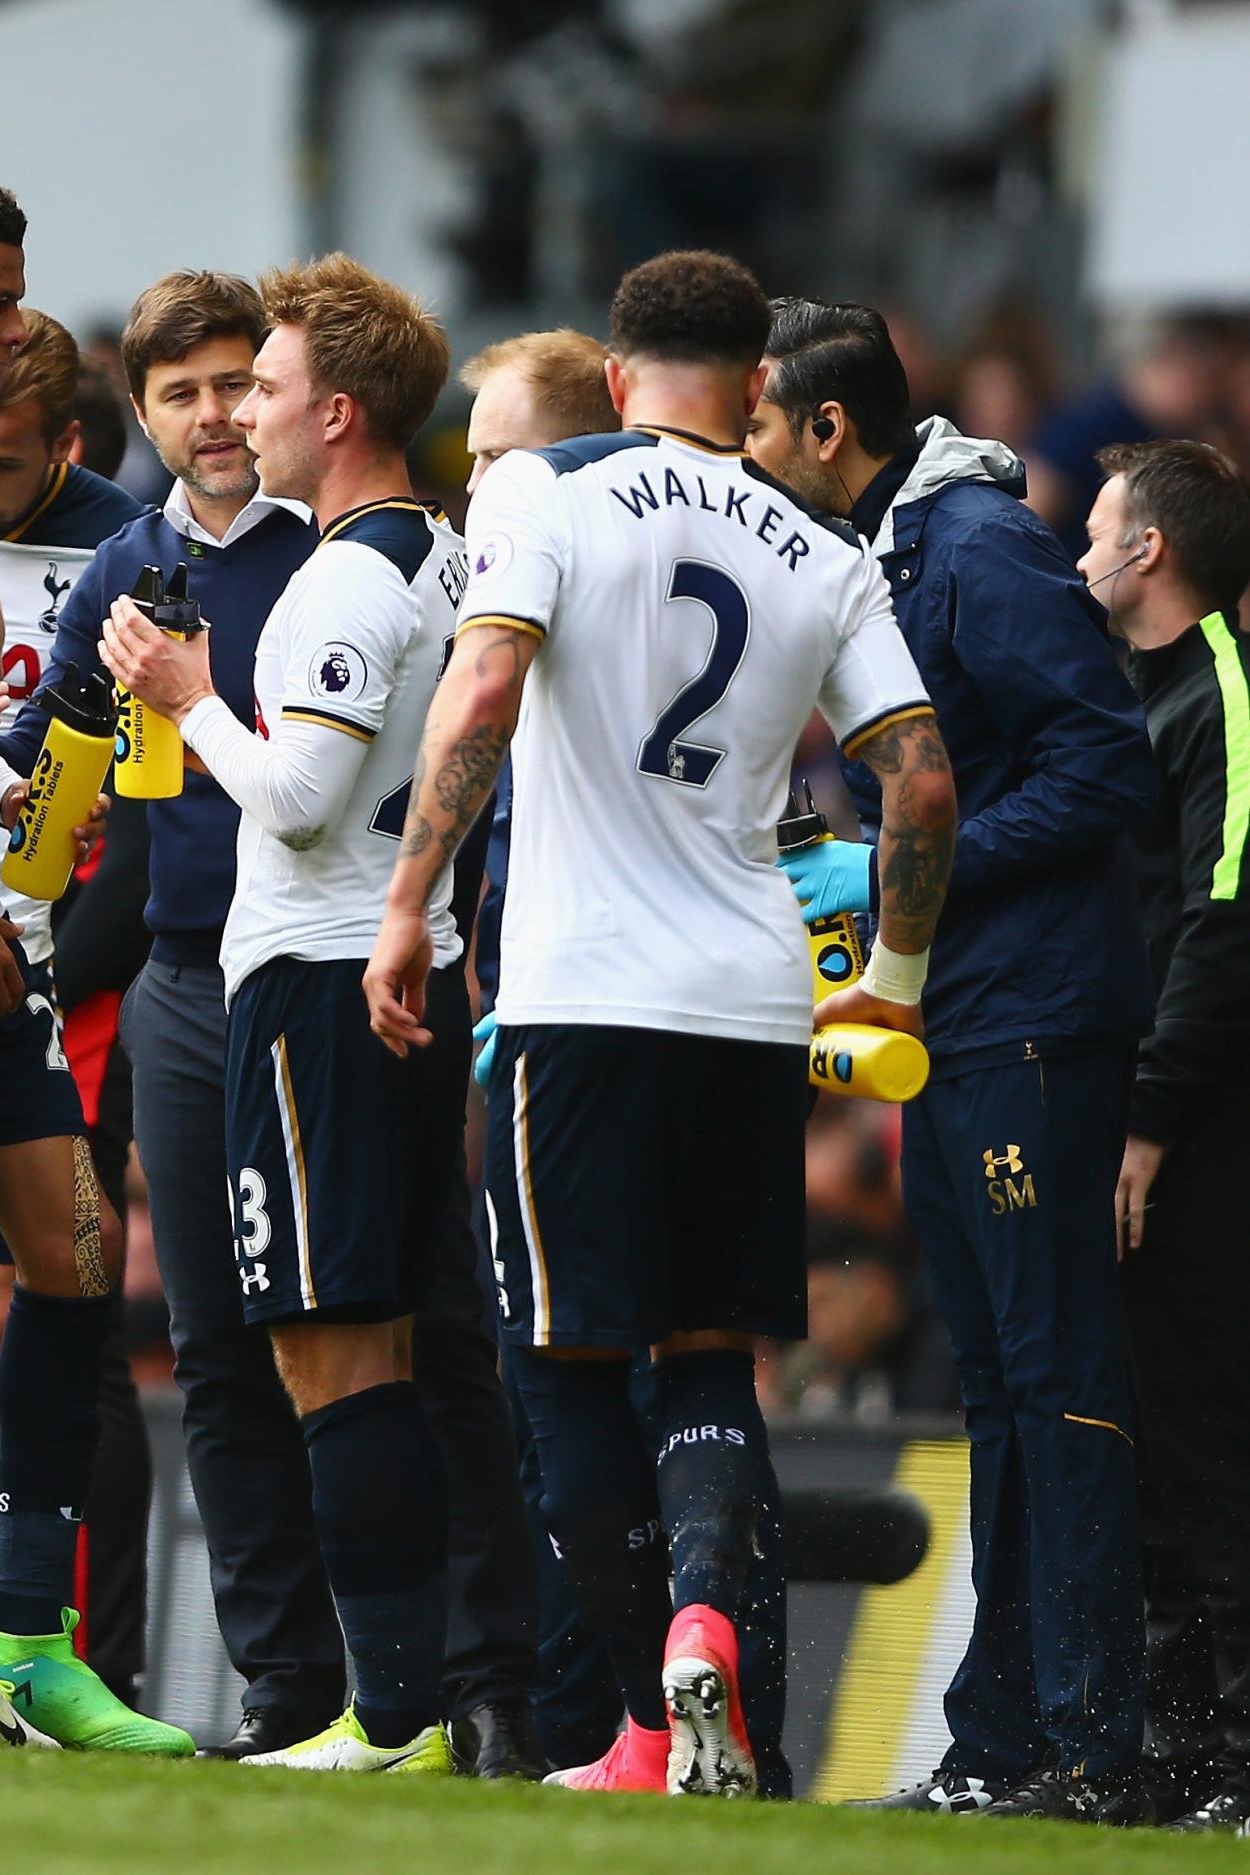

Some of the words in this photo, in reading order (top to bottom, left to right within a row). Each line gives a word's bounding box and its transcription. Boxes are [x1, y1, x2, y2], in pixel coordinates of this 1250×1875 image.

[609, 466, 810, 572] WALKER
[636, 556, 752, 789] 2
[133, 703, 146, 764] Hydration
[22, 806, 49, 862] Hydration
[41, 760, 64, 802] Tablets
[988, 1174, 1038, 1215] SM
